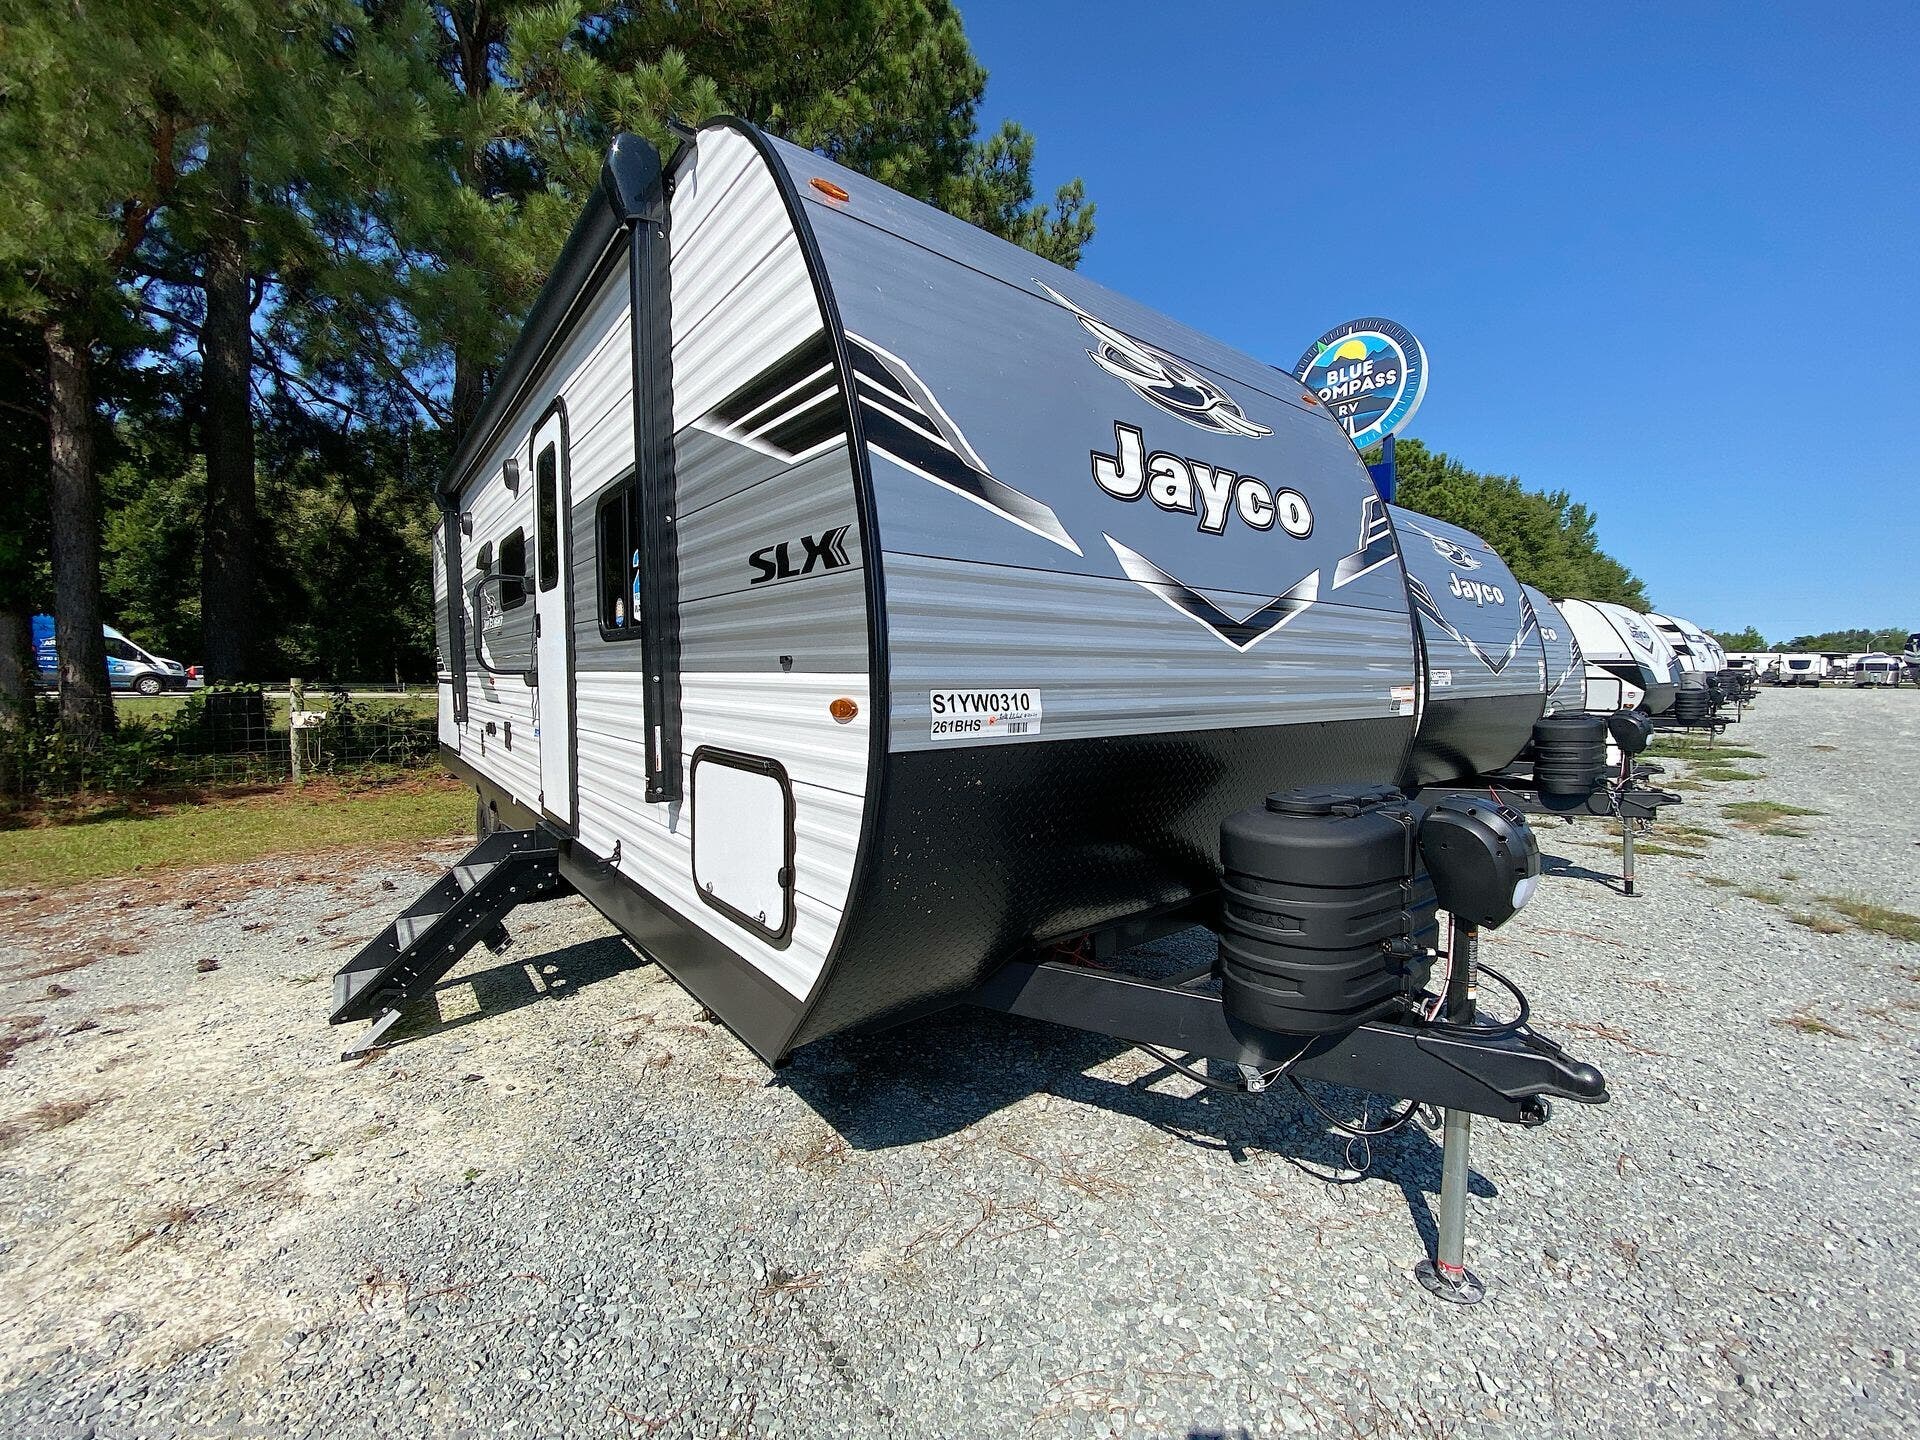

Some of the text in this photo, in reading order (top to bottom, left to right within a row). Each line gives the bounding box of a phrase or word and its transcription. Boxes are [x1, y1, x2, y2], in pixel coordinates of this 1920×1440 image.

[1316, 369, 1397, 402] OMPASS
[1326, 359, 1374, 386] BLUE
[1338, 402, 1359, 417] RV
[1090, 419, 1314, 540] Jayco
[748, 524, 852, 585] SLX
[1449, 571, 1505, 608] Jayco
[932, 692, 1030, 714] S1YW0310
[932, 720, 981, 733] 261BHS
